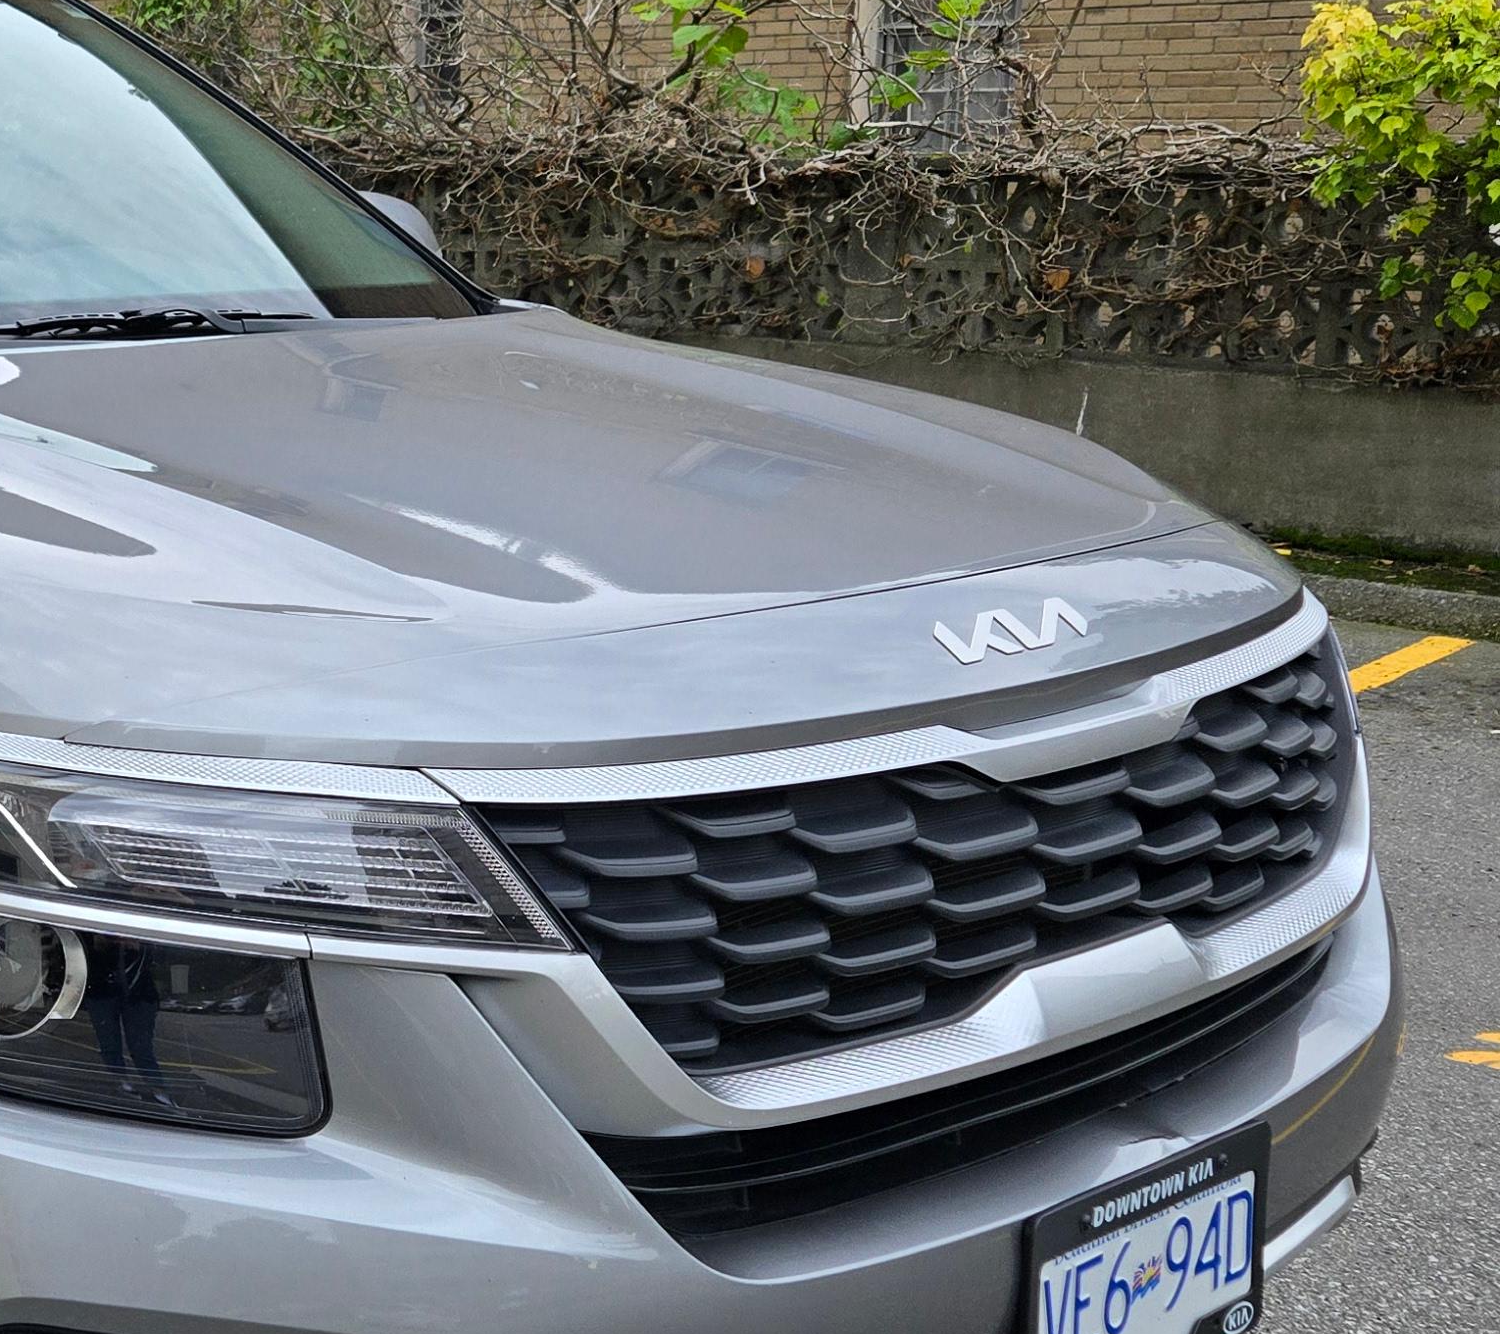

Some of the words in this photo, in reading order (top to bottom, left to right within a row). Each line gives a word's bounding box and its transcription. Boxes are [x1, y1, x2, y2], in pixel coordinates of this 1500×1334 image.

[1091, 1172, 1185, 1228] DOWNTOWN
[1187, 1157, 1214, 1187] KIA
[1165, 1189, 1253, 1313] 94D
